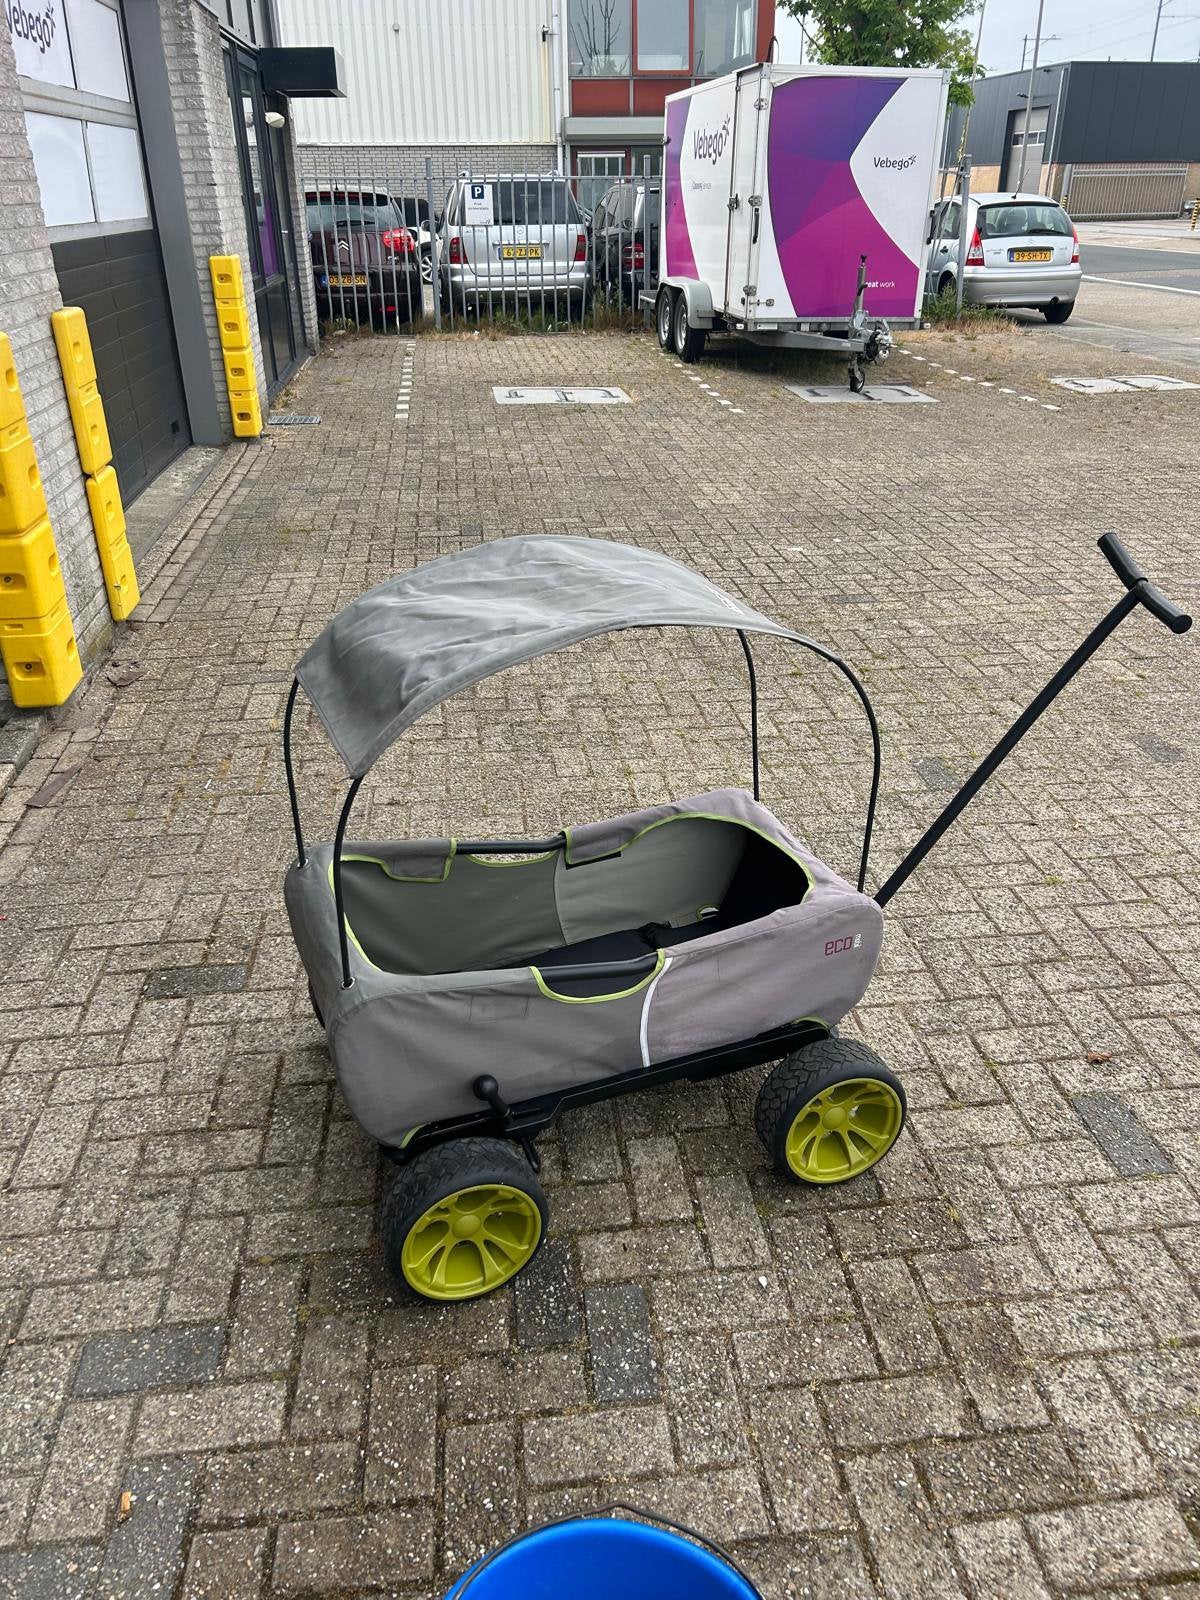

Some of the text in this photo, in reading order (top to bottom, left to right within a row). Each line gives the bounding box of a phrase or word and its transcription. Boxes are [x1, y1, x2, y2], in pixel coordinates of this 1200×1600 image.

[5, 0, 50, 54] Vebego
[693, 128, 724, 166] Vebego
[873, 156, 910, 171] Vebego
[474, 186, 482, 198] P
[1015, 252, 1048, 260] 39-SH-TX
[825, 936, 853, 956] eco
